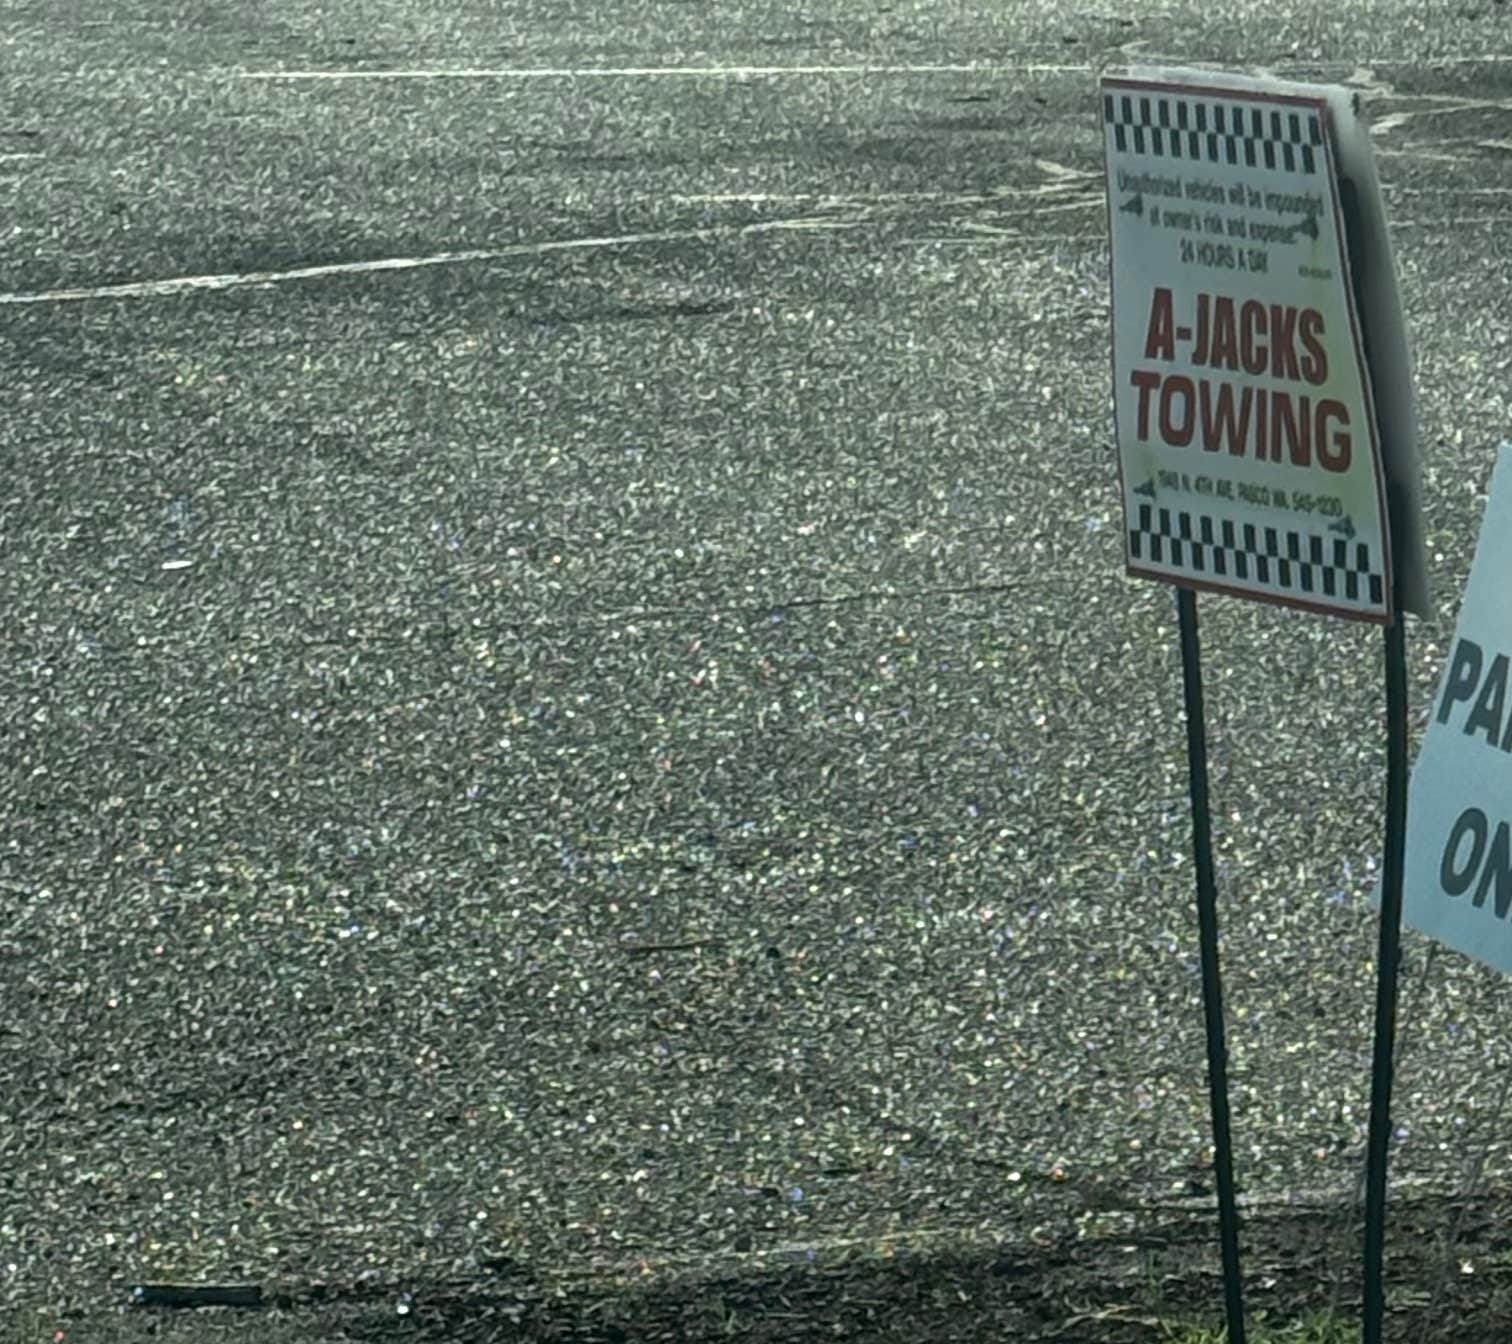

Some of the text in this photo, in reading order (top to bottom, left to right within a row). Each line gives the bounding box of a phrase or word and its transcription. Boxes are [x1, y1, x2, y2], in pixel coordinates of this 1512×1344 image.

[1197, 241, 1236, 270] HOURS
[1237, 247, 1247, 272] A
[1144, 286, 1329, 387] A-JACKS
[1130, 369, 1353, 475] TOWING
